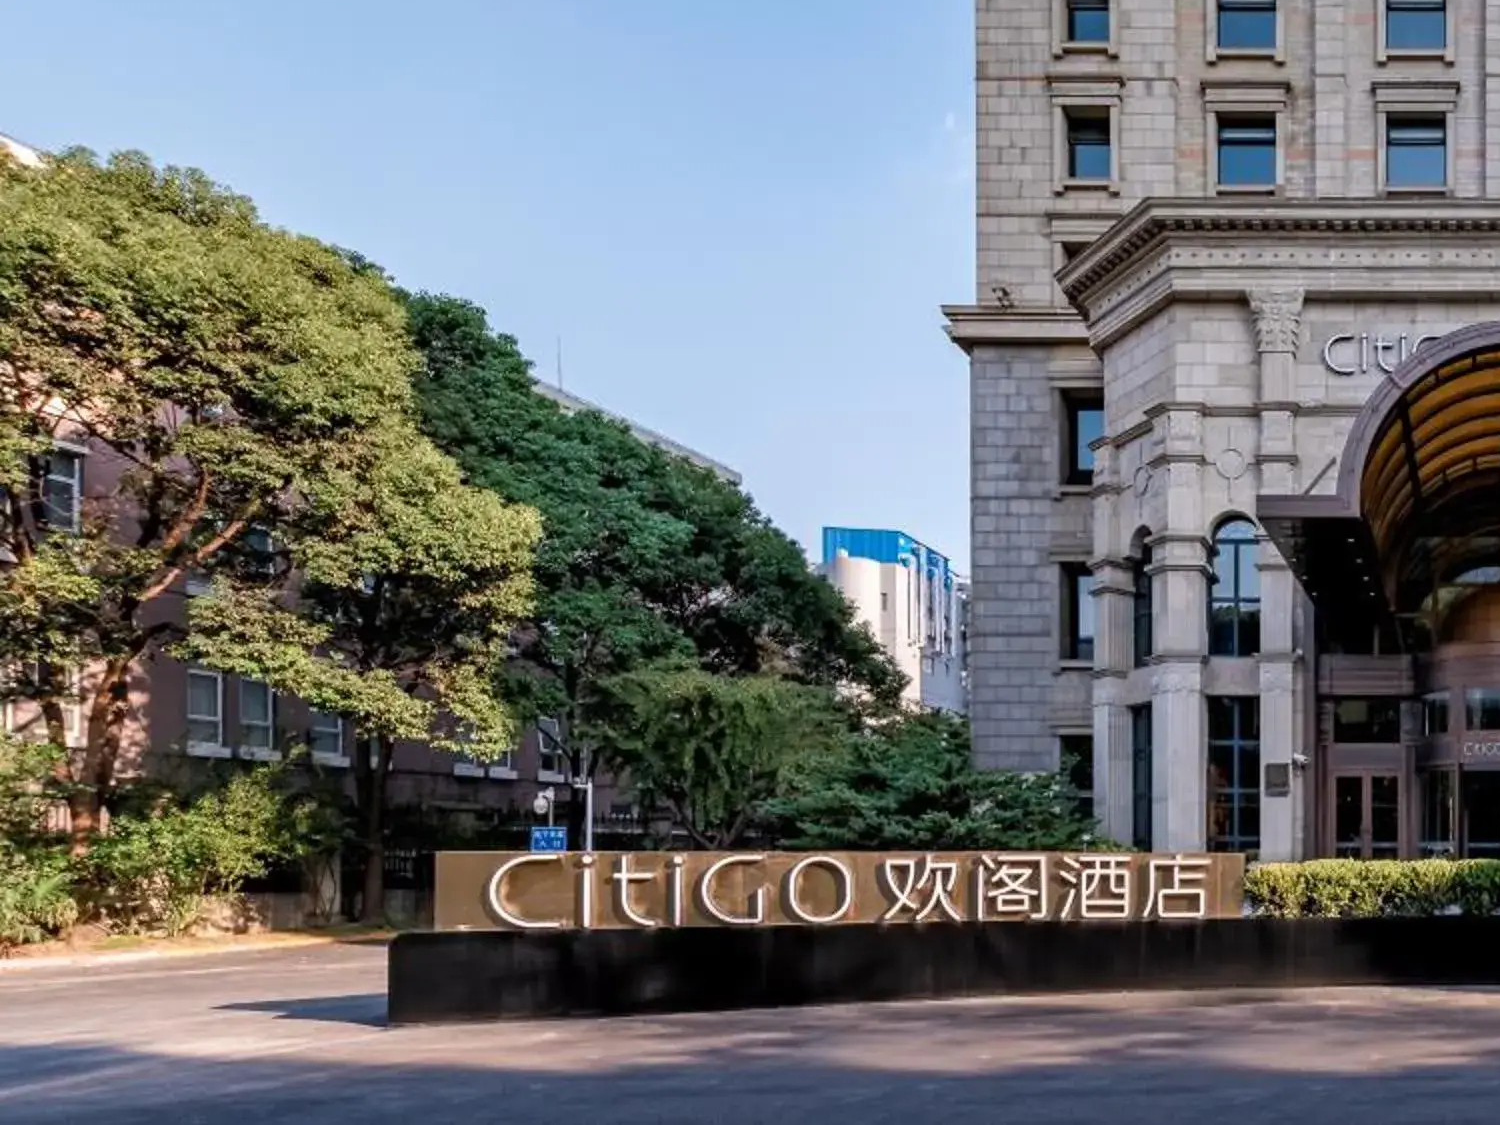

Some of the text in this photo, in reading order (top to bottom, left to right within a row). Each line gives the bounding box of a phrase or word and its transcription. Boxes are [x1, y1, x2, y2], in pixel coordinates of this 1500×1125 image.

[489, 853, 1213, 928] CitiGO 欢阁酒店
